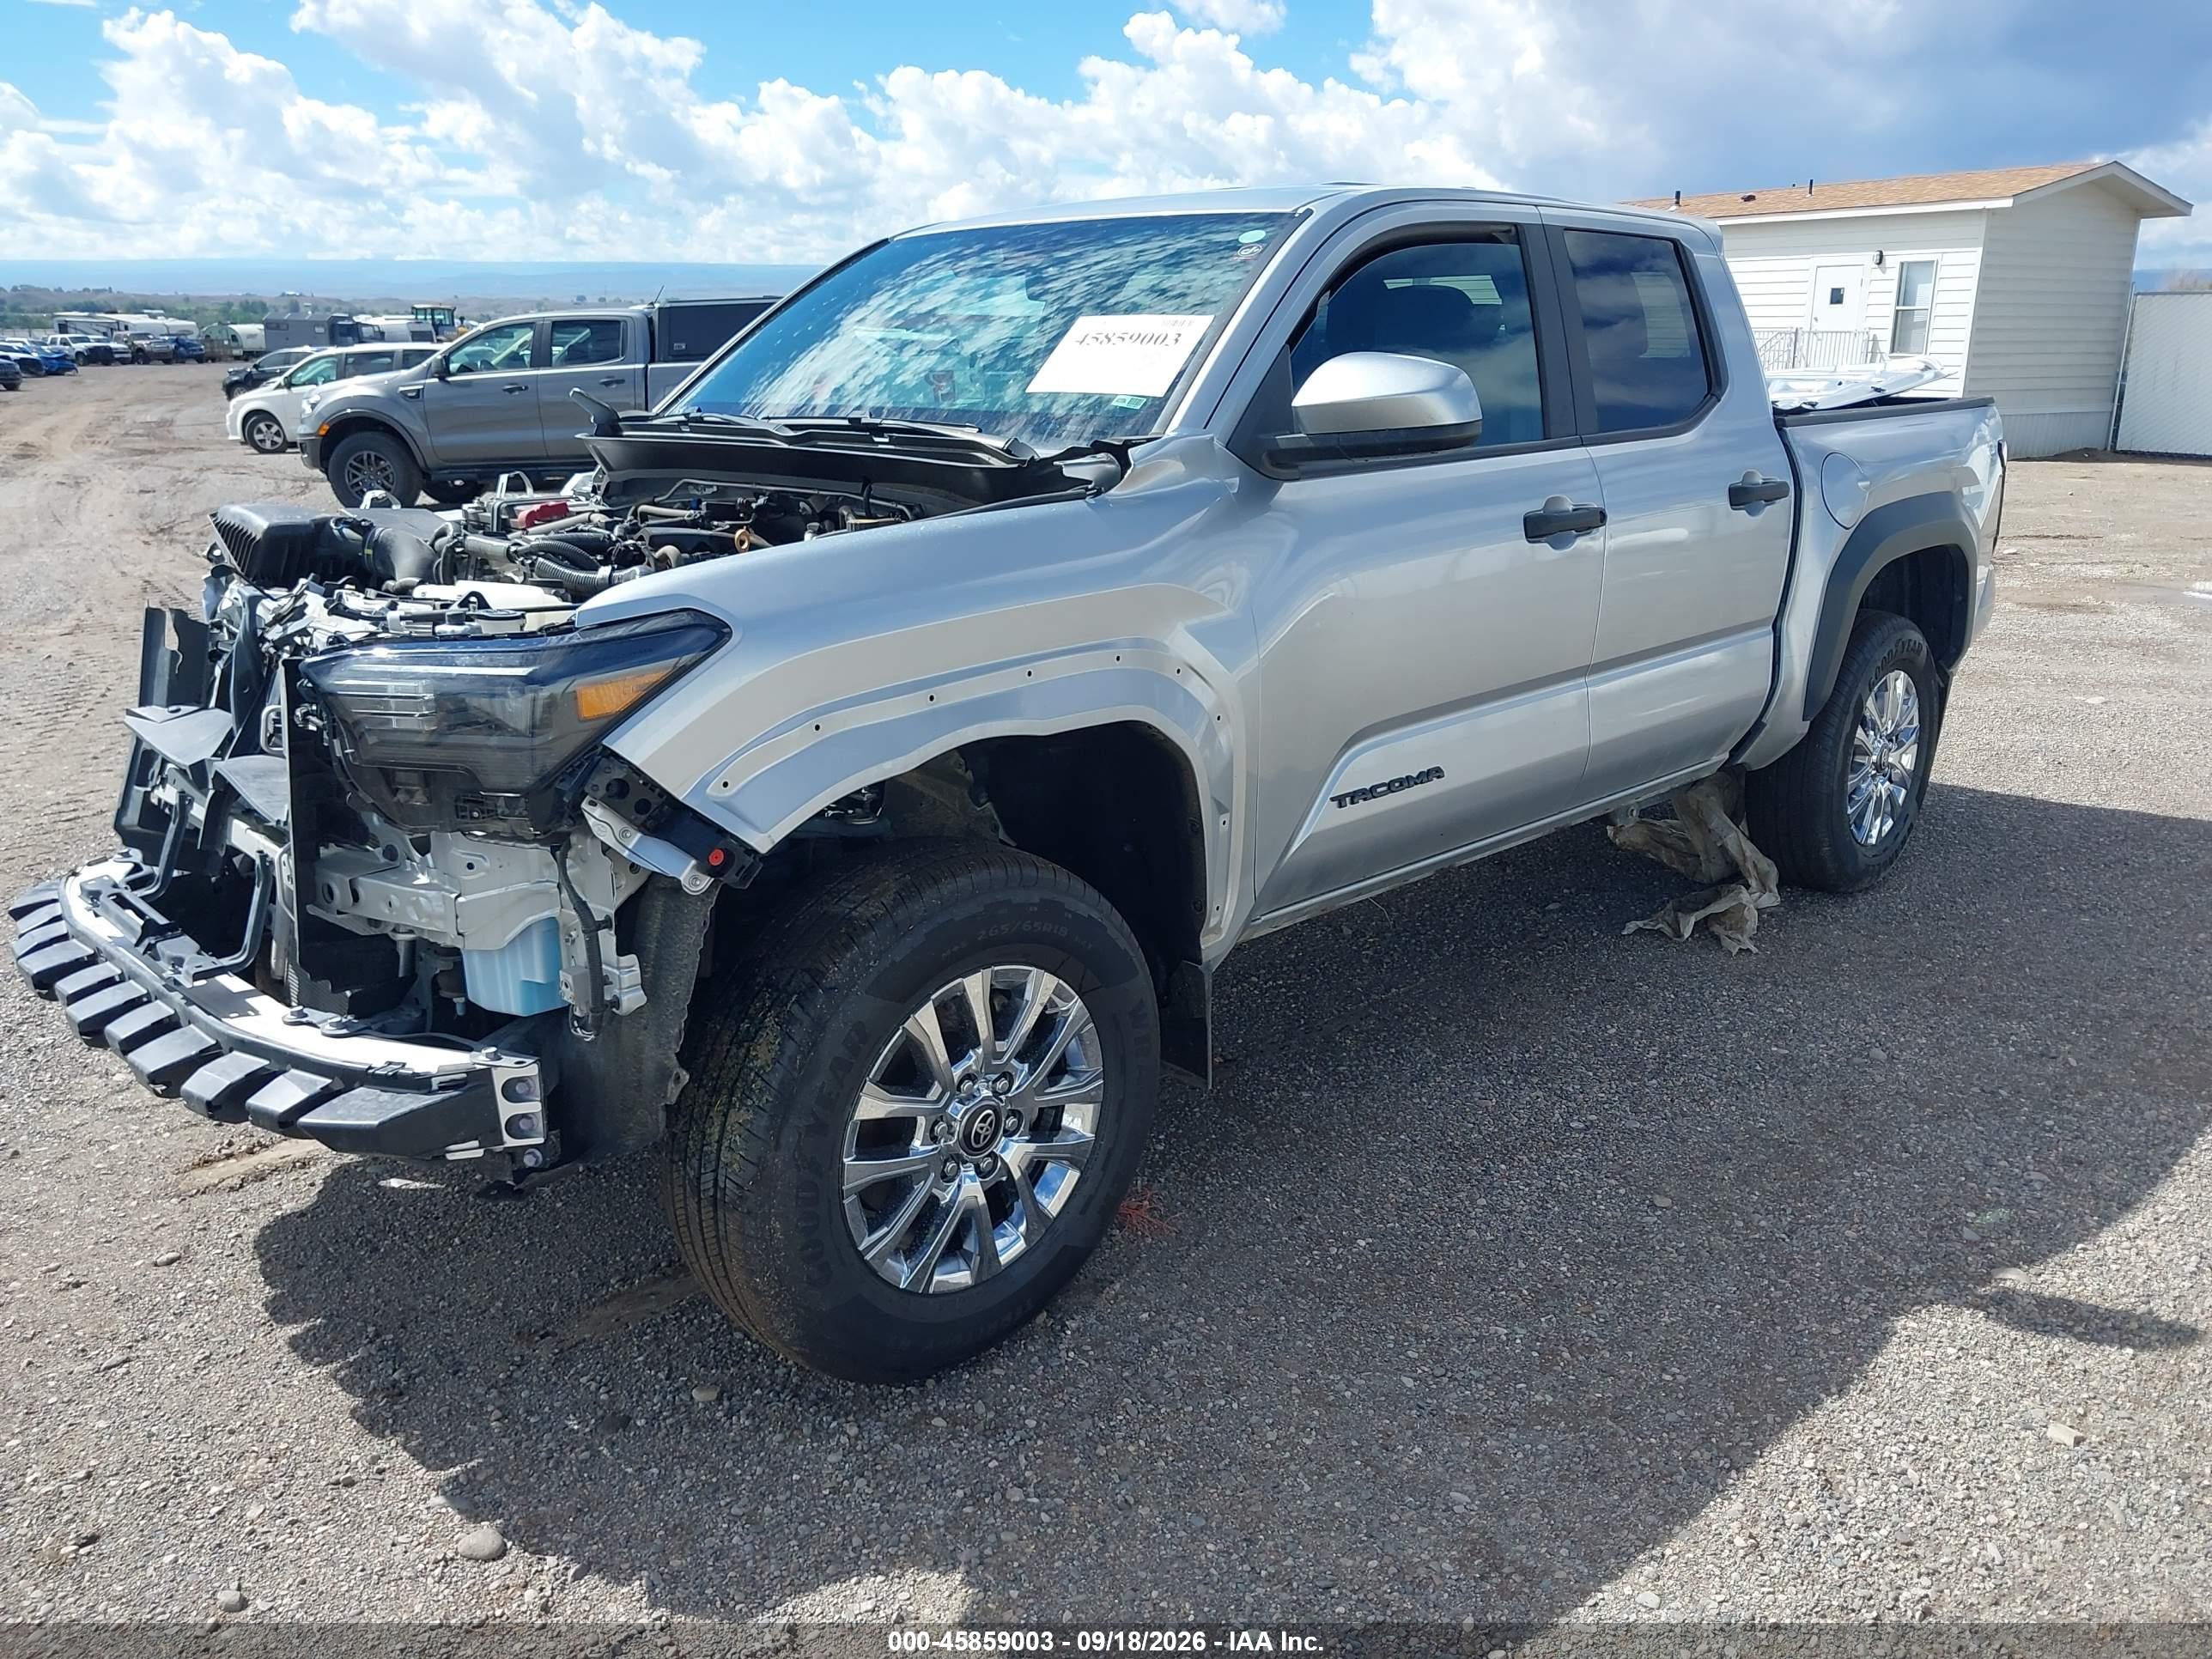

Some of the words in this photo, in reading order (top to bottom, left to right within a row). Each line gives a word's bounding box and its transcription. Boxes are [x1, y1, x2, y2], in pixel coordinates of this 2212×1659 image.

[1076, 332, 1182, 346] 45859003
[1869, 638, 1923, 693] GOODYEAR
[1329, 766, 1445, 809] TACOMA
